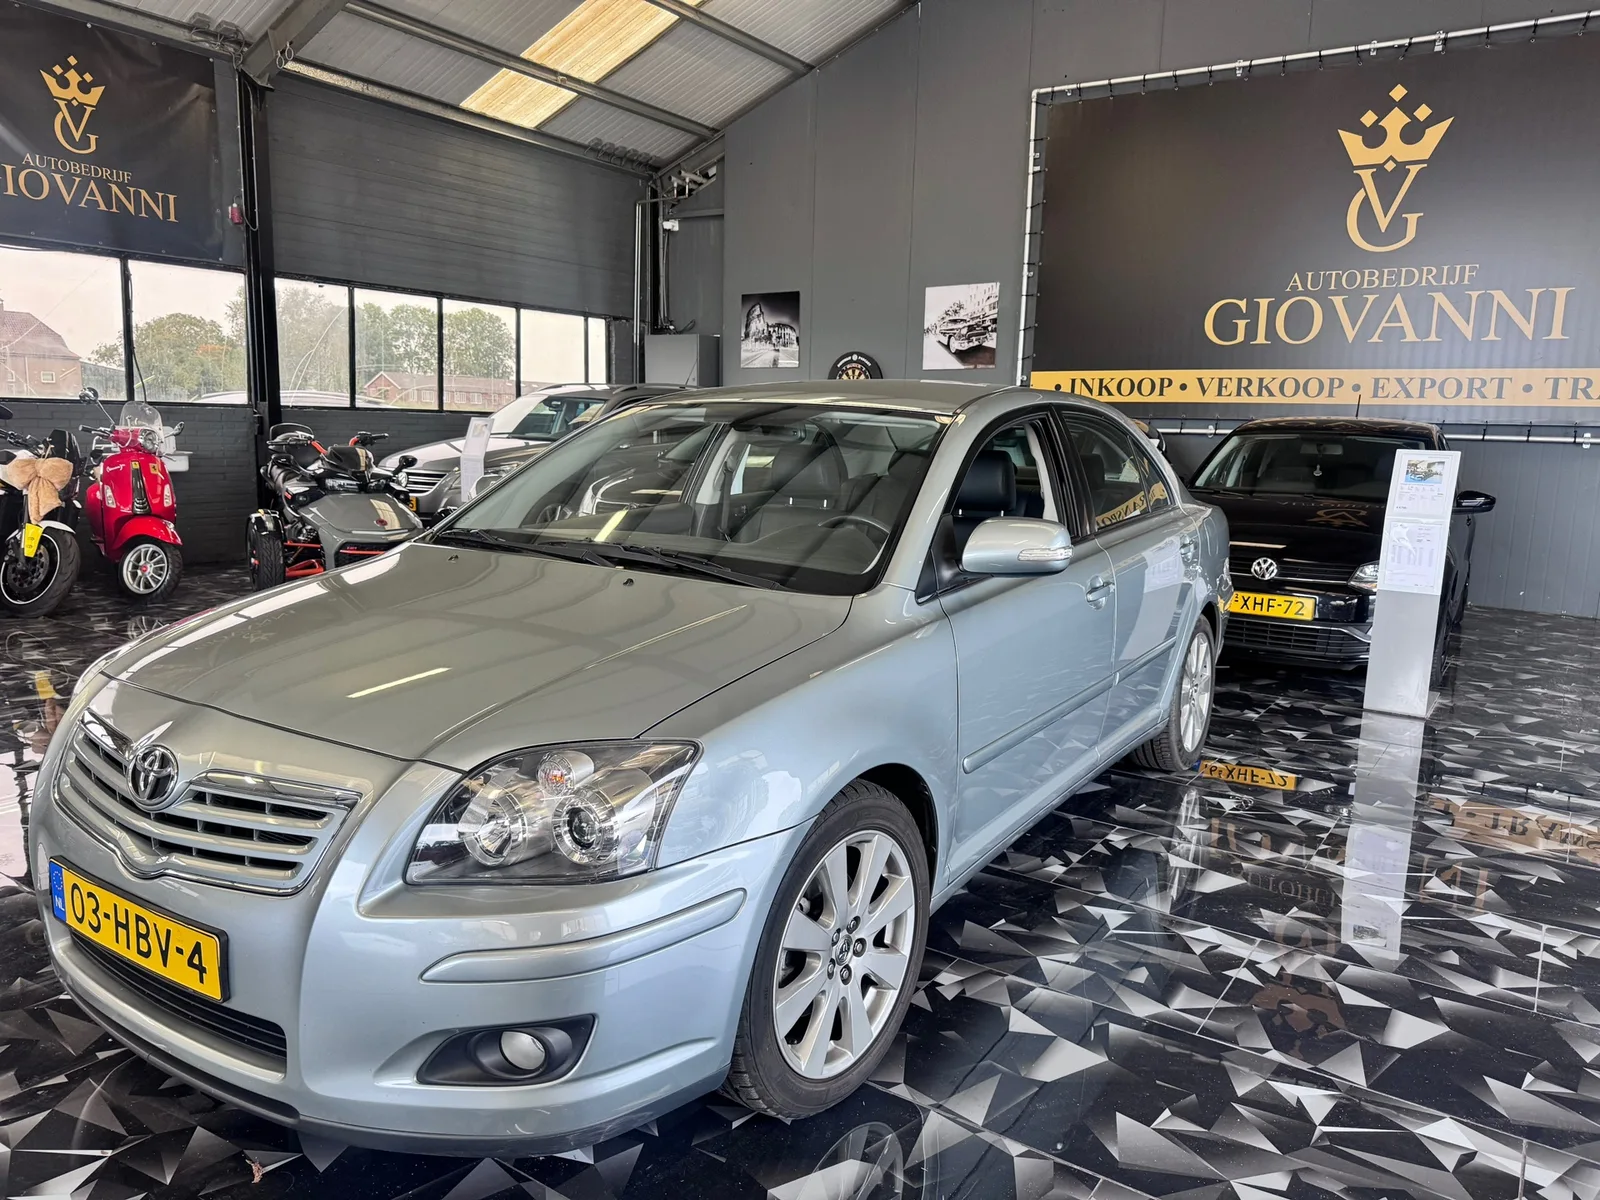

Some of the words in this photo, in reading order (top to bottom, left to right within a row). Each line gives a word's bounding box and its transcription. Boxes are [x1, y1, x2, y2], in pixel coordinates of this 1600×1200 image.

[22, 152, 132, 184] AUTOBEDRIJF
[0, 163, 179, 223] IOVANNI
[1285, 264, 1480, 292] AUTOBEDRIJF
[1203, 287, 1576, 346] GIOVANNI
[1069, 377, 1173, 397] INKOOP
[1196, 377, 1345, 398] VERKOOP
[1370, 376, 1513, 399] EXPORT
[1544, 376, 1600, 400] TR
[54, 895, 65, 911] NL
[71, 882, 208, 985] 03-HBV-4
